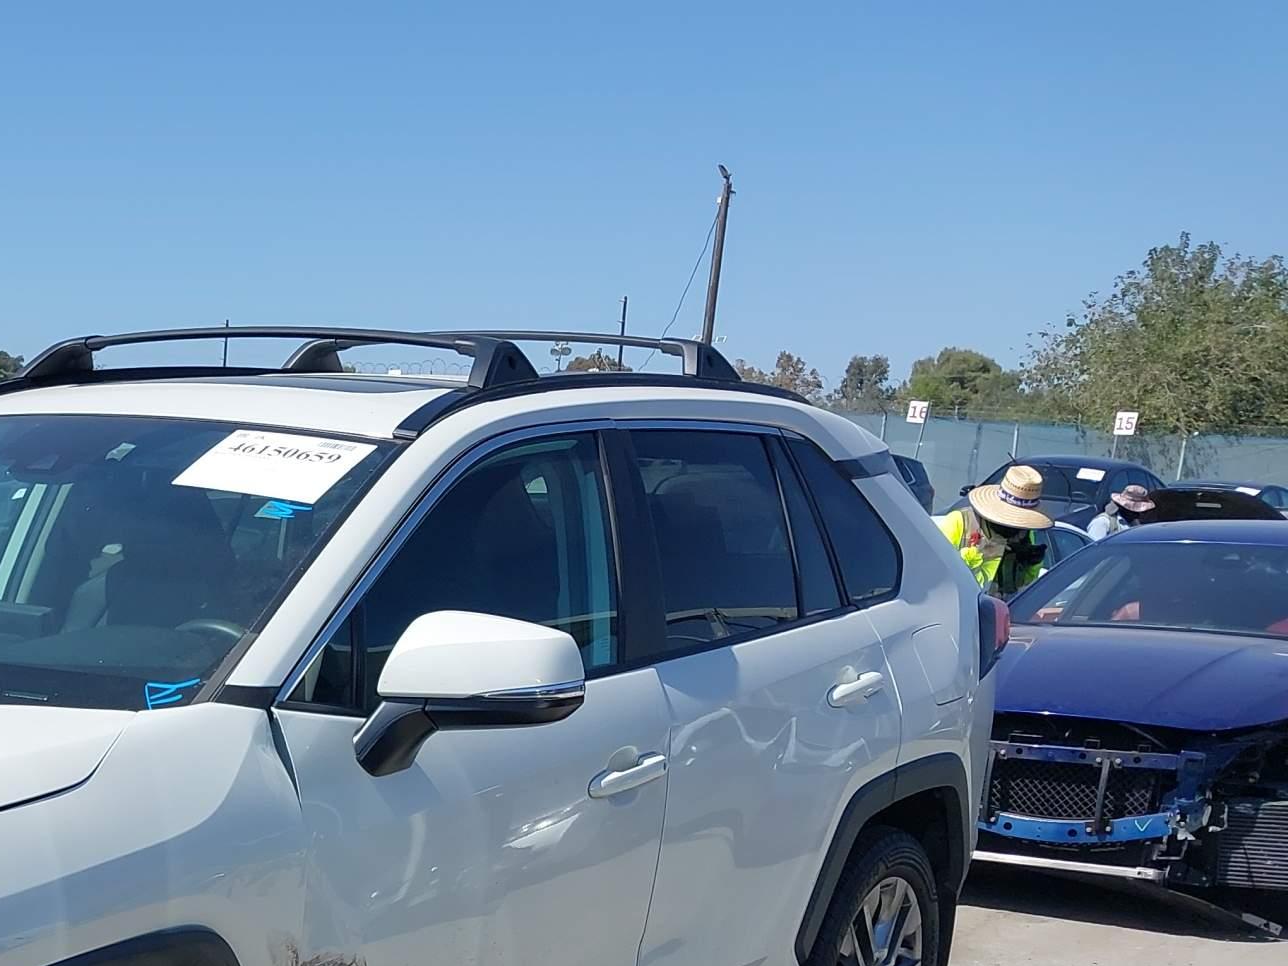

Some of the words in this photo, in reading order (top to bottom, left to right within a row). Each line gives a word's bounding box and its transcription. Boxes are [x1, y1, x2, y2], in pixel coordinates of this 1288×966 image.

[909, 406, 927, 419] 16
[1116, 416, 1135, 430] 15
[228, 442, 342, 463] 46150659
